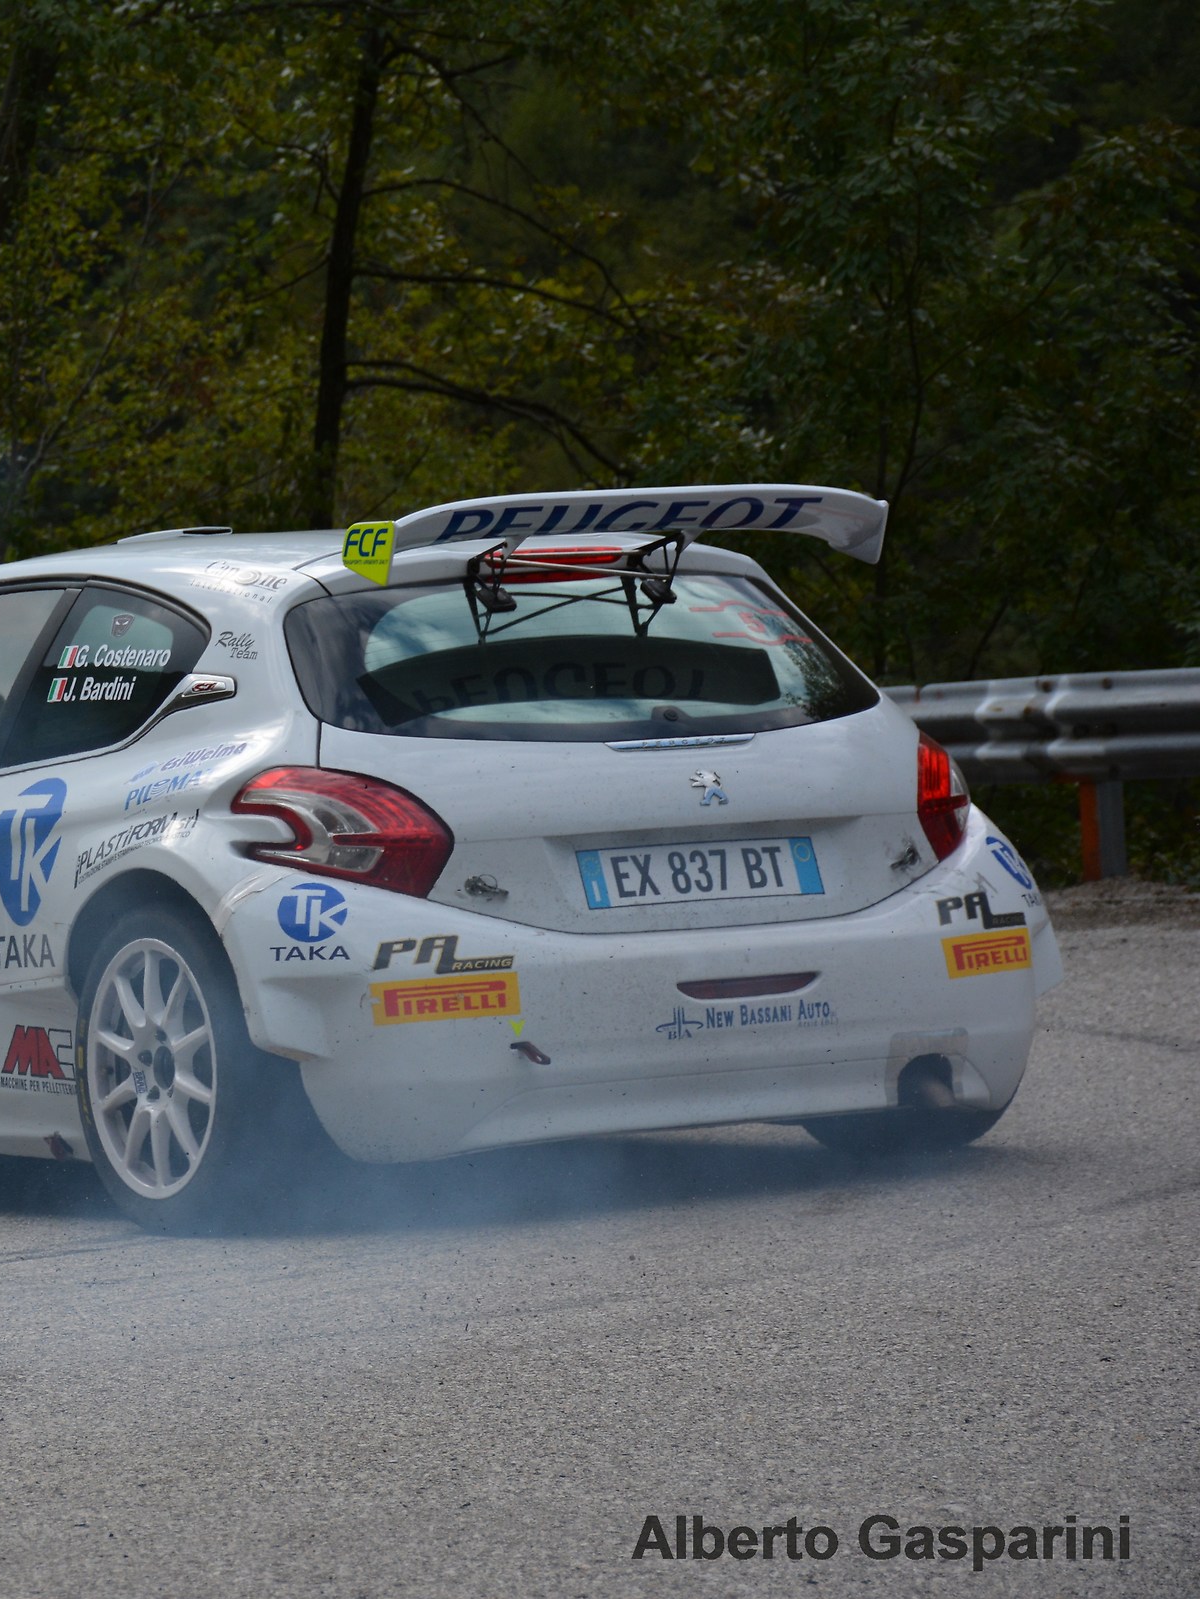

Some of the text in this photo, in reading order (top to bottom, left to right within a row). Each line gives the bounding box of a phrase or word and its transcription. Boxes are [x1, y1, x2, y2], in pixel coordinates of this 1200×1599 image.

[434, 497, 822, 544] PEUGEOT
[344, 528, 388, 557] FCF
[215, 631, 255, 652] Rally
[230, 647, 258, 660] Team
[75, 644, 171, 667] G. Costenaro
[63, 676, 136, 702] J. Bardini
[610, 846, 784, 898] EX 837 BT
[269, 945, 350, 962] TAKA
[452, 958, 513, 971] RACING
[952, 935, 1028, 971] PIRELLI
[383, 980, 507, 1018] PIRELLI
[0, 1076, 28, 1091] MACCHINE
[29, 1081, 41, 1092] PER
